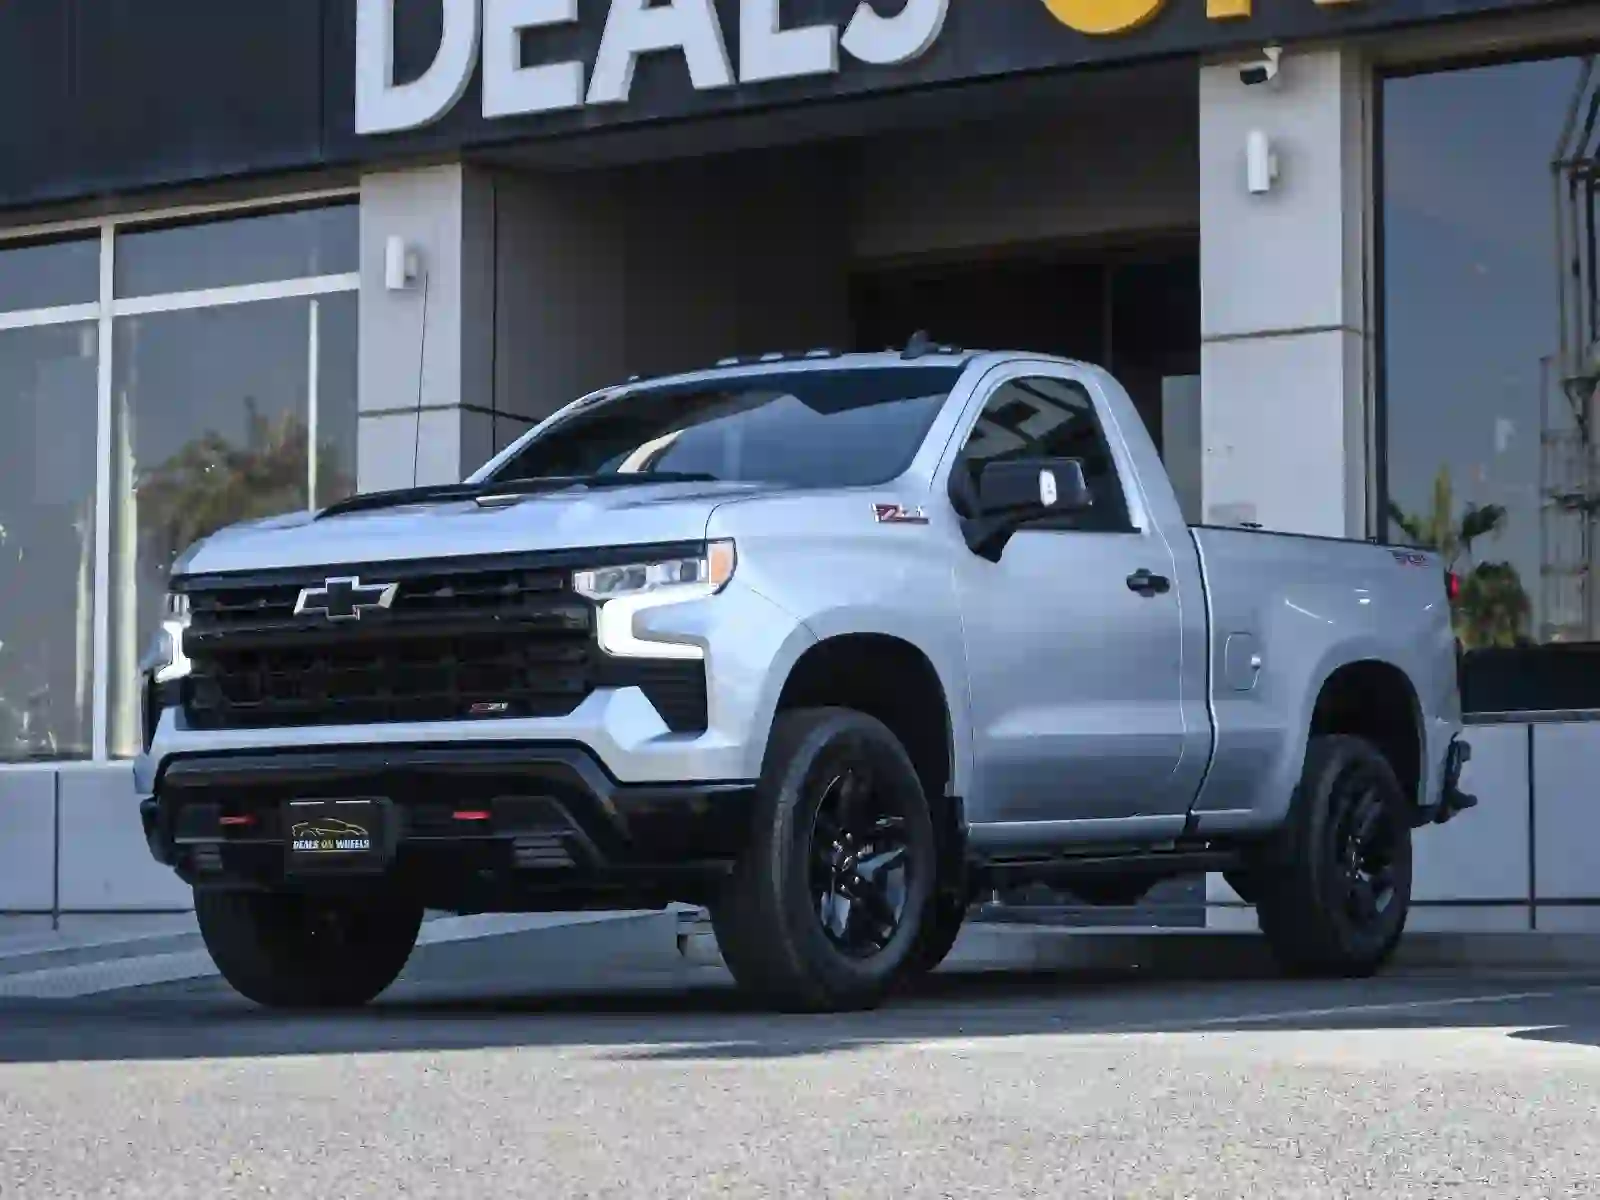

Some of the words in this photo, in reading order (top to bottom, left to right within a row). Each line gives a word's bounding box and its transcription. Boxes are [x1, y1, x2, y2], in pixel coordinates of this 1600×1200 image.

[293, 839, 319, 850] DEALS
[320, 839, 334, 849] ON
[335, 839, 370, 849] WHEELS
